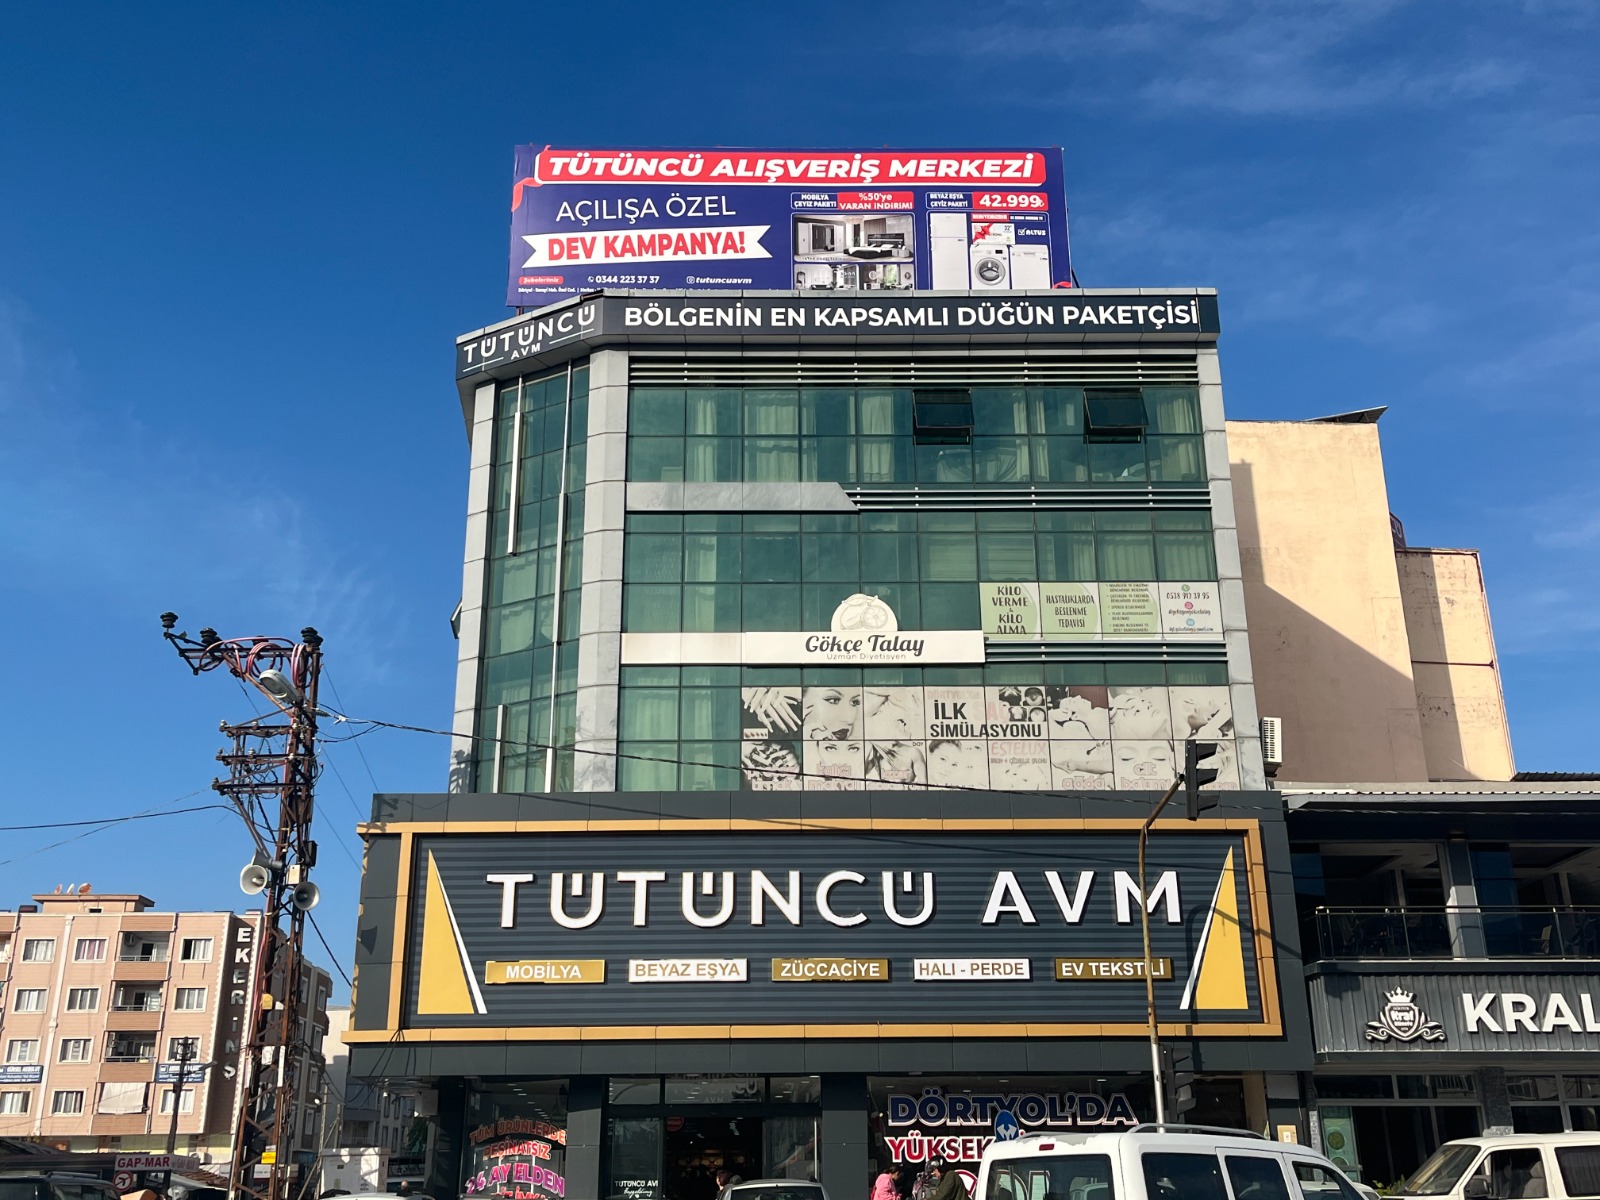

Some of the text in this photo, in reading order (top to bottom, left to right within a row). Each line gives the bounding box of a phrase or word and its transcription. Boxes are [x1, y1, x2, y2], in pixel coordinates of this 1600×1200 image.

[549, 152, 1034, 183] TÜTÜNCÜ ALIŞVERİŞ MERKEZİ
[556, 193, 736, 226] AÇILIŞA ÖZEL
[839, 202, 872, 210] VARAN
[548, 231, 746, 261] DEV KAMPANYA!
[595, 275, 660, 283] 0344 223 37 37
[695, 276, 752, 284] tutuncuavm
[624, 300, 1199, 330] BÖLGENİN EN KAPSAMLI DÜĞÜN PAKETÇİSİ
[462, 304, 596, 365] TÜTÜNCÜ
[511, 343, 541, 360] AVM
[997, 585, 1022, 597] KİLO
[991, 597, 1029, 607] VERME
[1046, 594, 1096, 605] HASTALIKLARDA
[998, 612, 1023, 624] KİLO
[1054, 607, 1087, 616] BESLENME
[996, 625, 1027, 635] ALMA
[1058, 618, 1086, 628] TEDAVİSİ
[805, 634, 925, 657] Gökçe Talay
[860, 652, 906, 662] Diyetisyen
[934, 699, 967, 720] İLK
[930, 722, 1042, 738] SİMÜLASYONU
[486, 870, 1182, 929] TÜTÜNCÜ AVM
[505, 963, 582, 979] MOBİLYA
[634, 962, 741, 979] BEYAZ EŞYA
[780, 959, 880, 977] ZÜCCACİYE
[918, 962, 956, 976] HALI
[969, 962, 1025, 976] PERDE
[1061, 962, 1084, 976] EV
[1462, 992, 1600, 1033] KRAL
[888, 1086, 1140, 1127] DÖRTYOL'DA
[469, 1115, 568, 1147] TÜM ÜRÜNLERDE
[885, 1130, 997, 1164] YÜKSEK
[117, 1156, 170, 1168] GAP-MAR
[487, 1163, 512, 1187] AY
[512, 1162, 565, 1198] ELDEN
